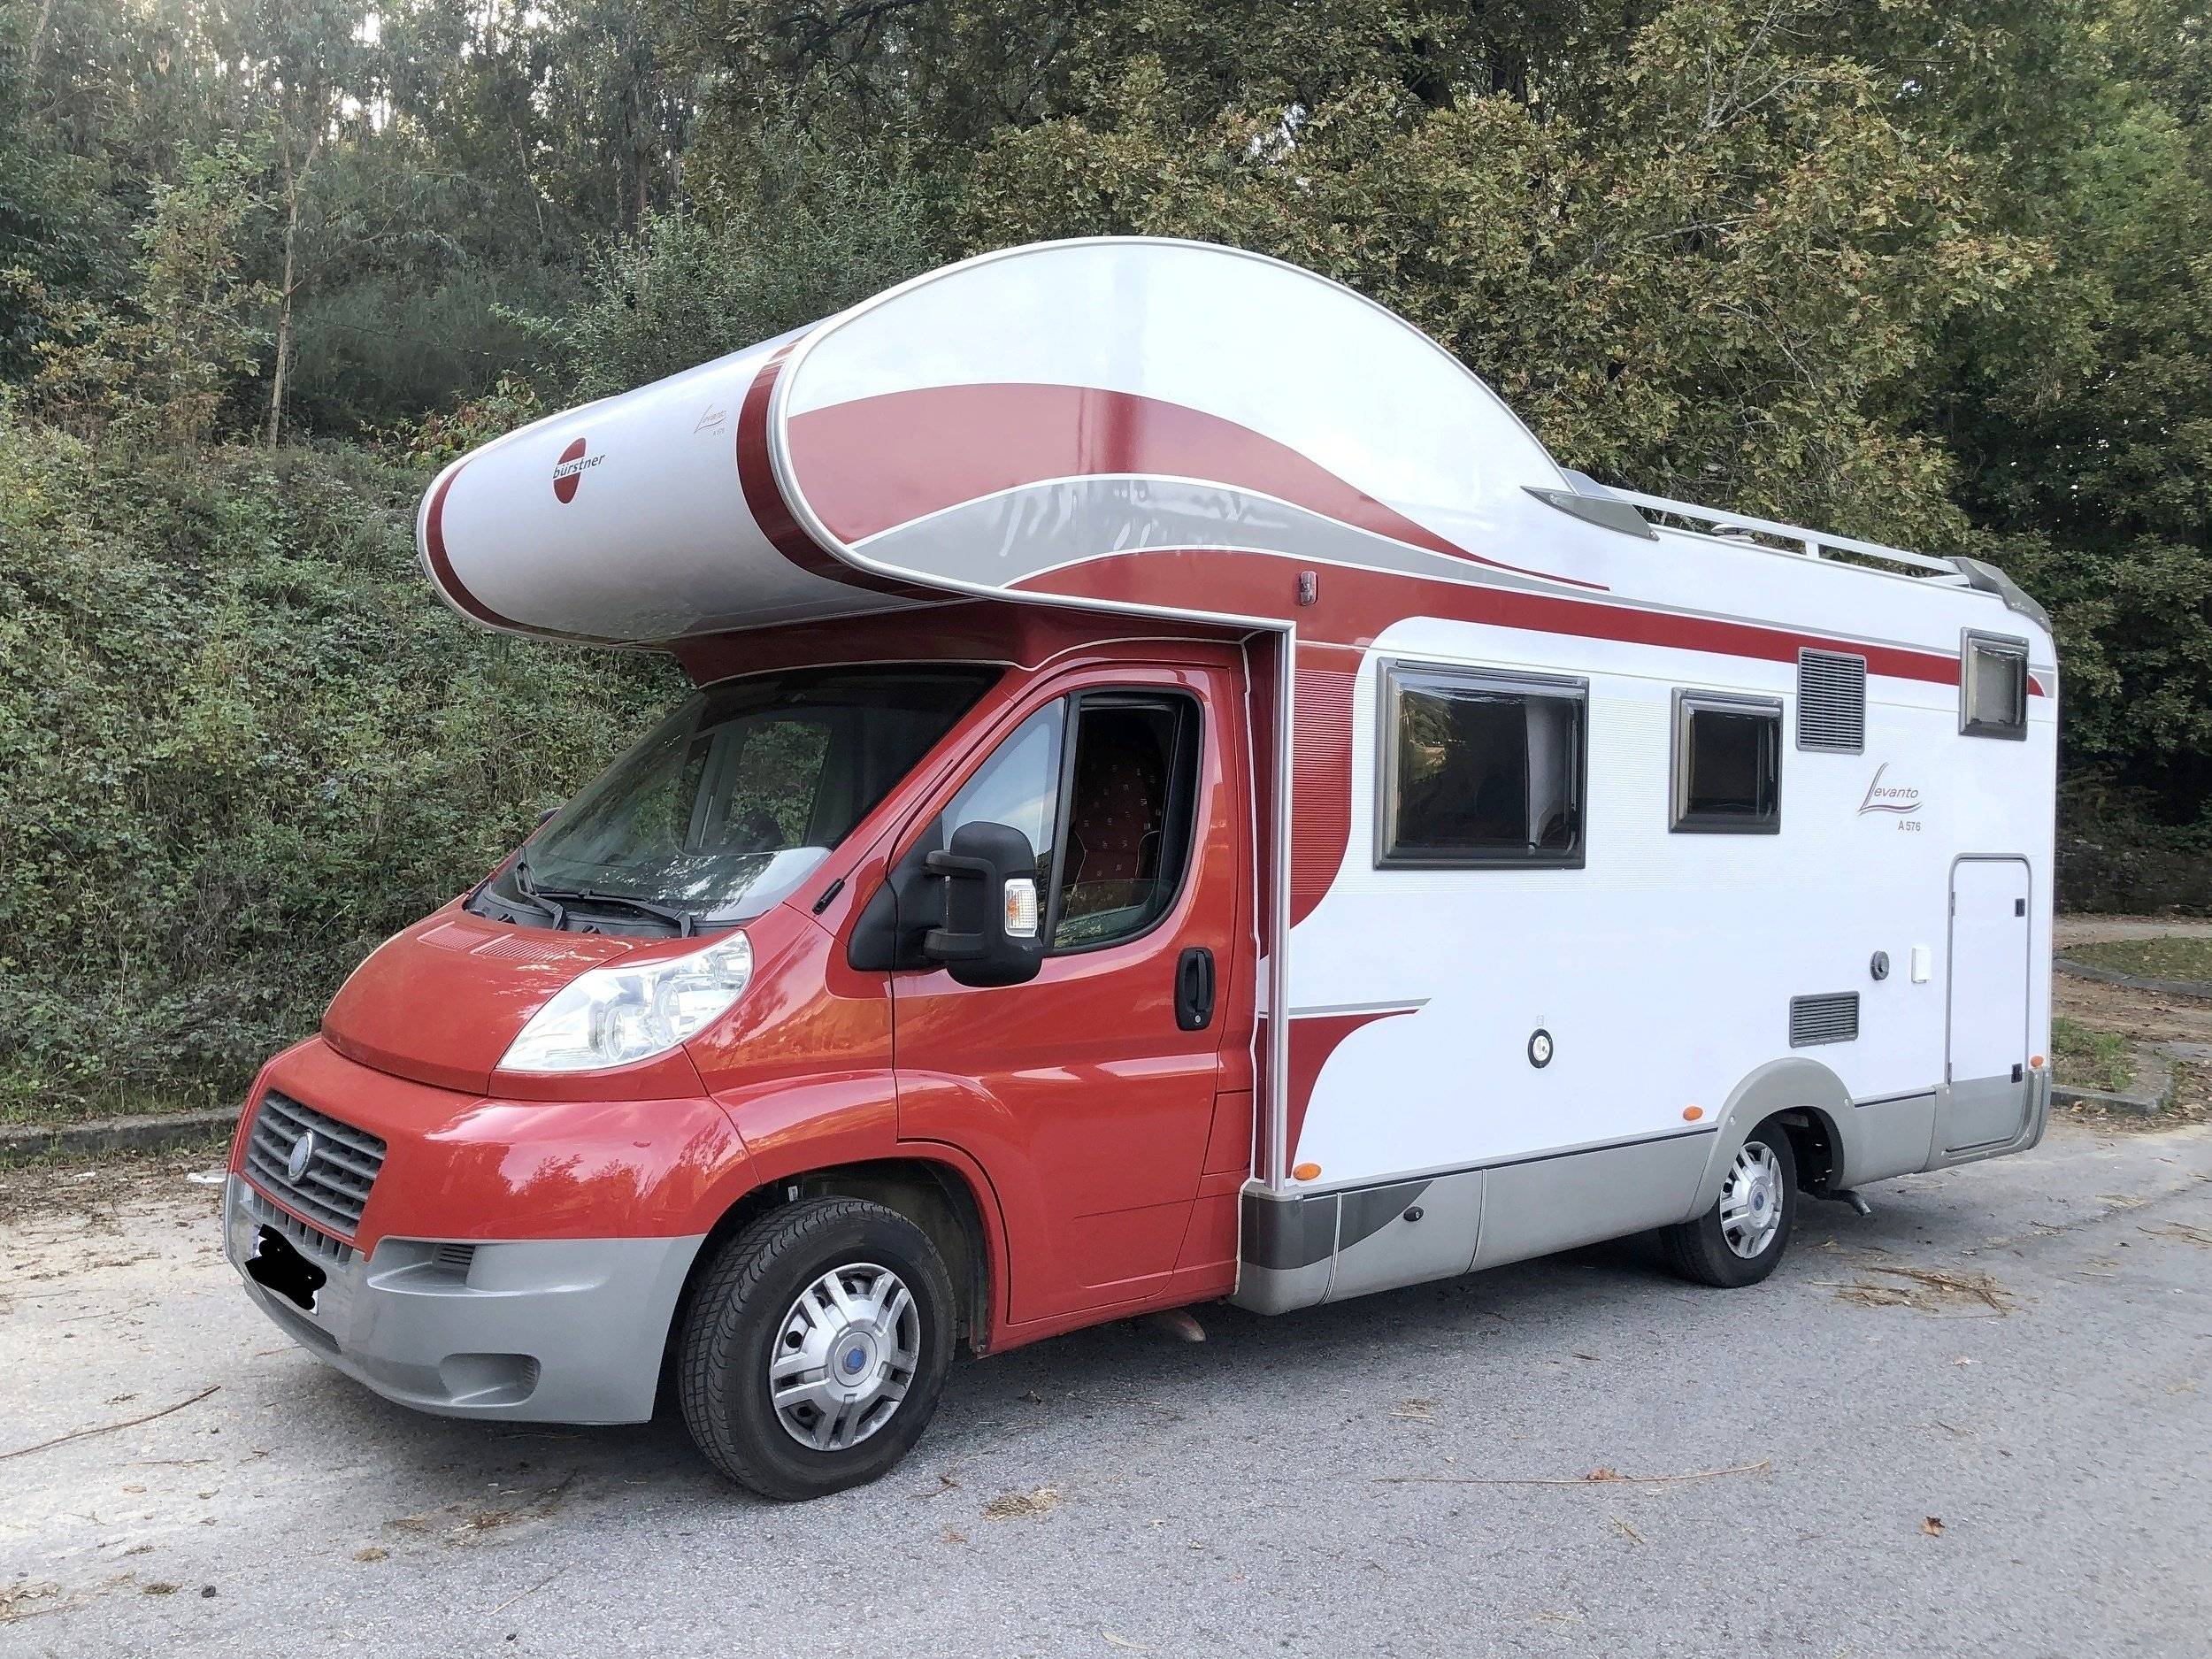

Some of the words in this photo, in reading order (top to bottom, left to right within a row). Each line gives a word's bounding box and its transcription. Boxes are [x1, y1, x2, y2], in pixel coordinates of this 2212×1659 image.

[552, 454, 607, 480] bürstner
[1856, 761, 1924, 816] Levanto
[1897, 819, 1905, 831] A
[1906, 821, 1922, 832] 576
